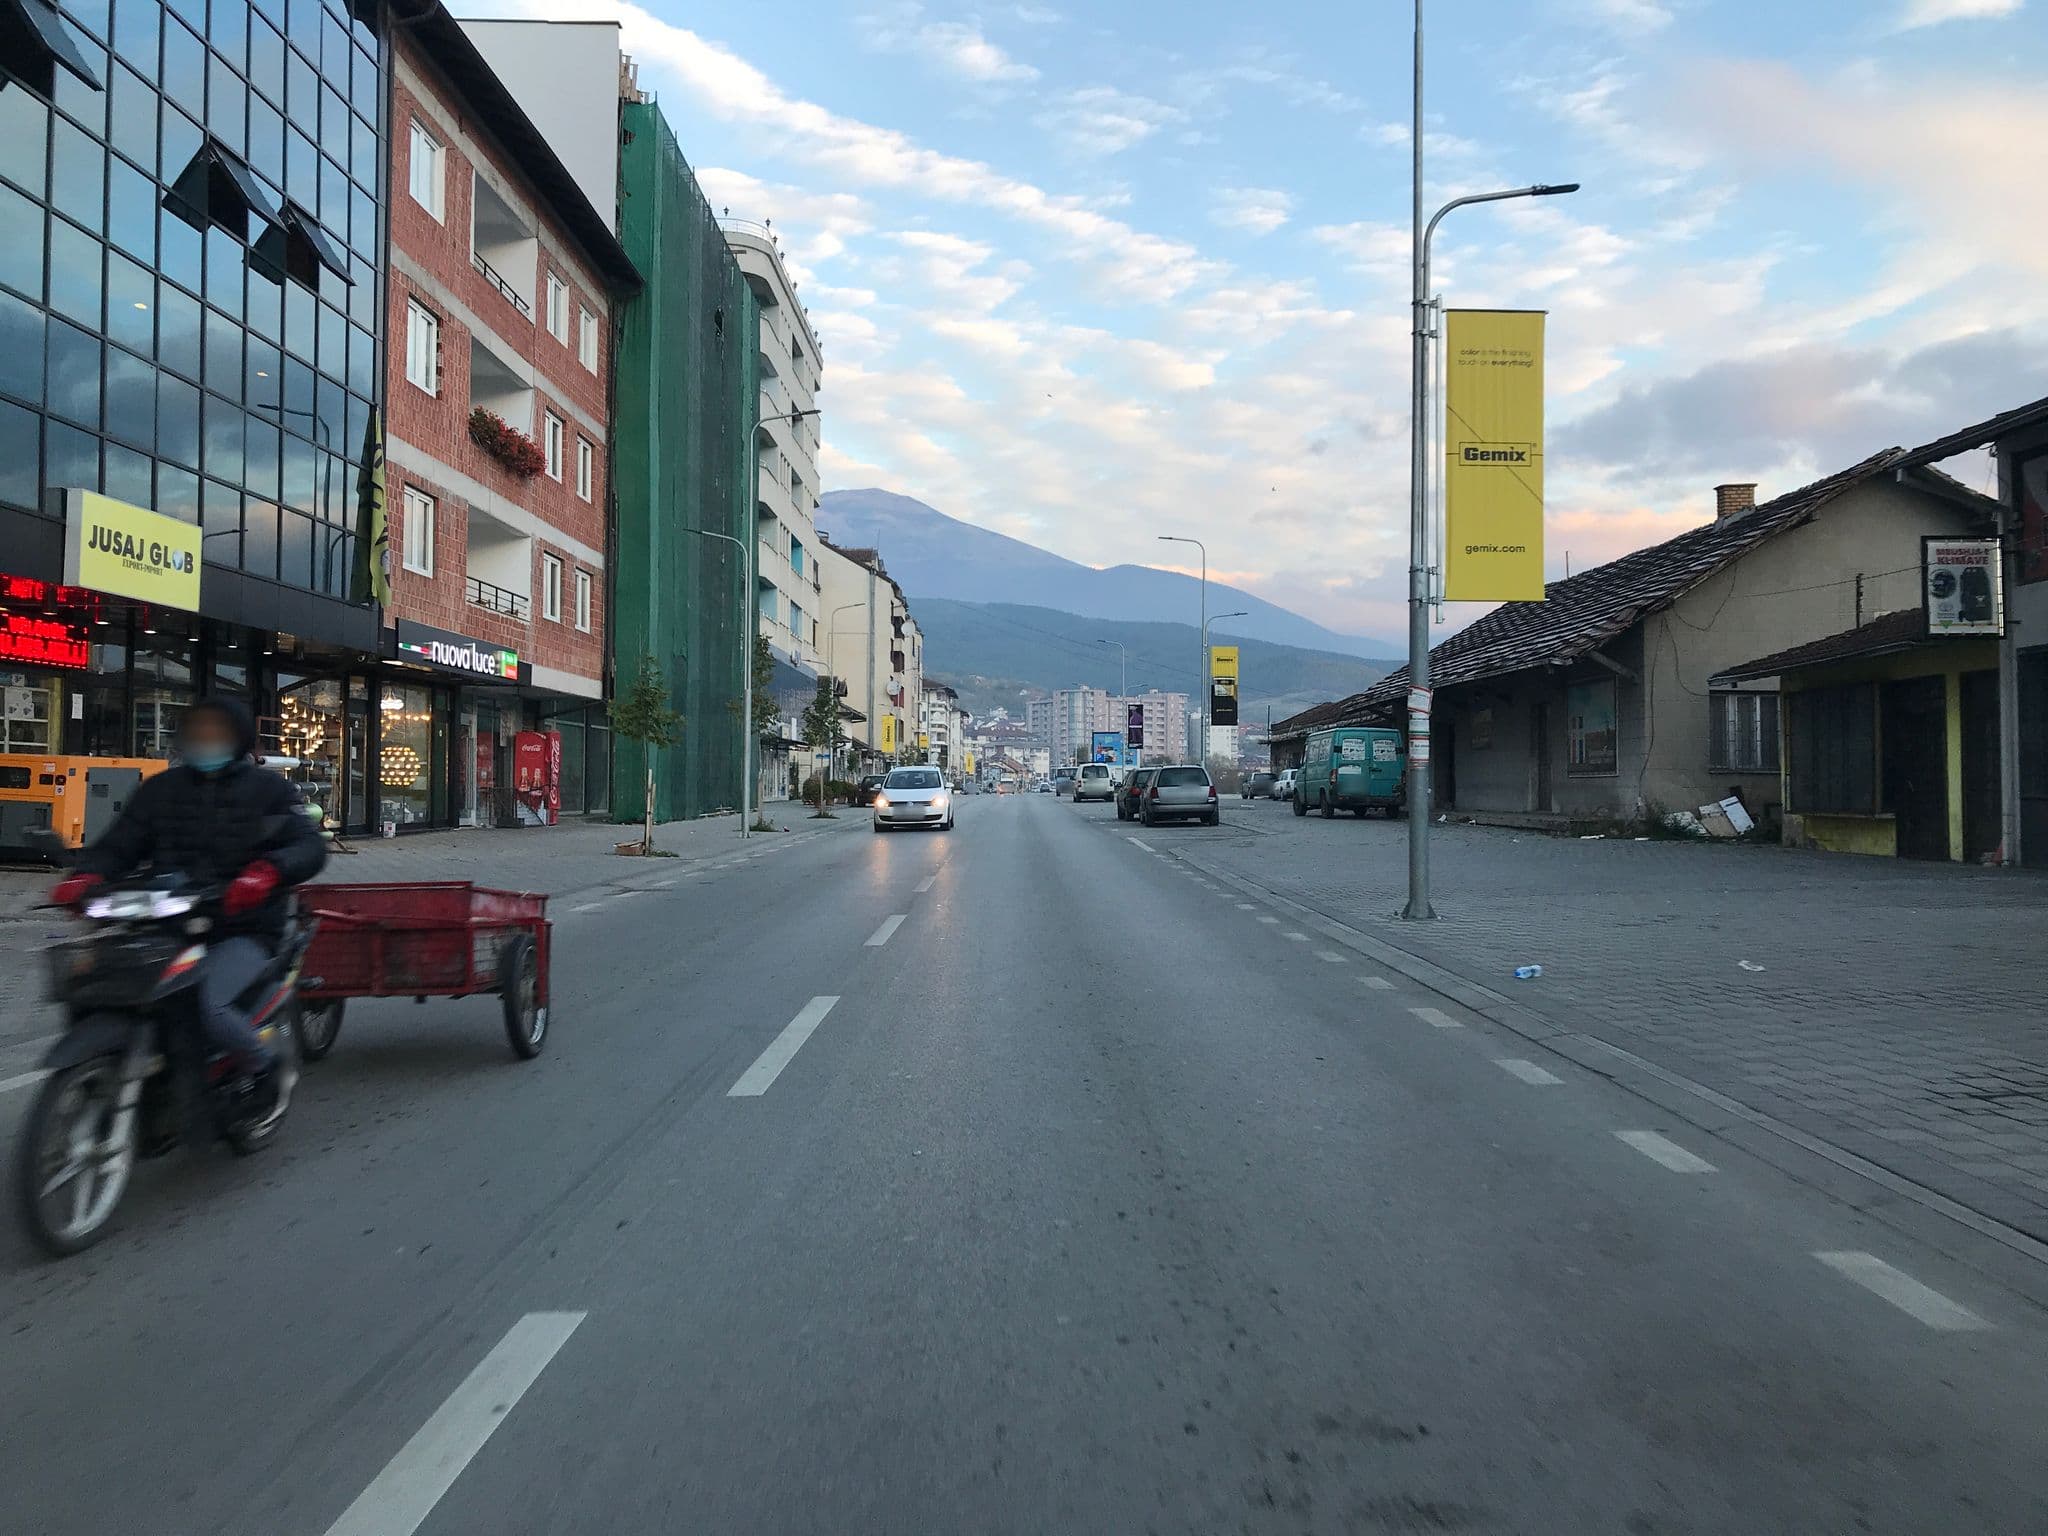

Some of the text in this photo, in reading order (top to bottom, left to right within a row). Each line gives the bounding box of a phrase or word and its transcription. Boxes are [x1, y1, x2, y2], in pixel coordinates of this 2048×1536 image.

[1464, 445, 1526, 462] Gemix
[88, 525, 145, 561] JUSAJ
[1465, 543, 1526, 555] gemix.com
[432, 640, 496, 675] nuova luce
